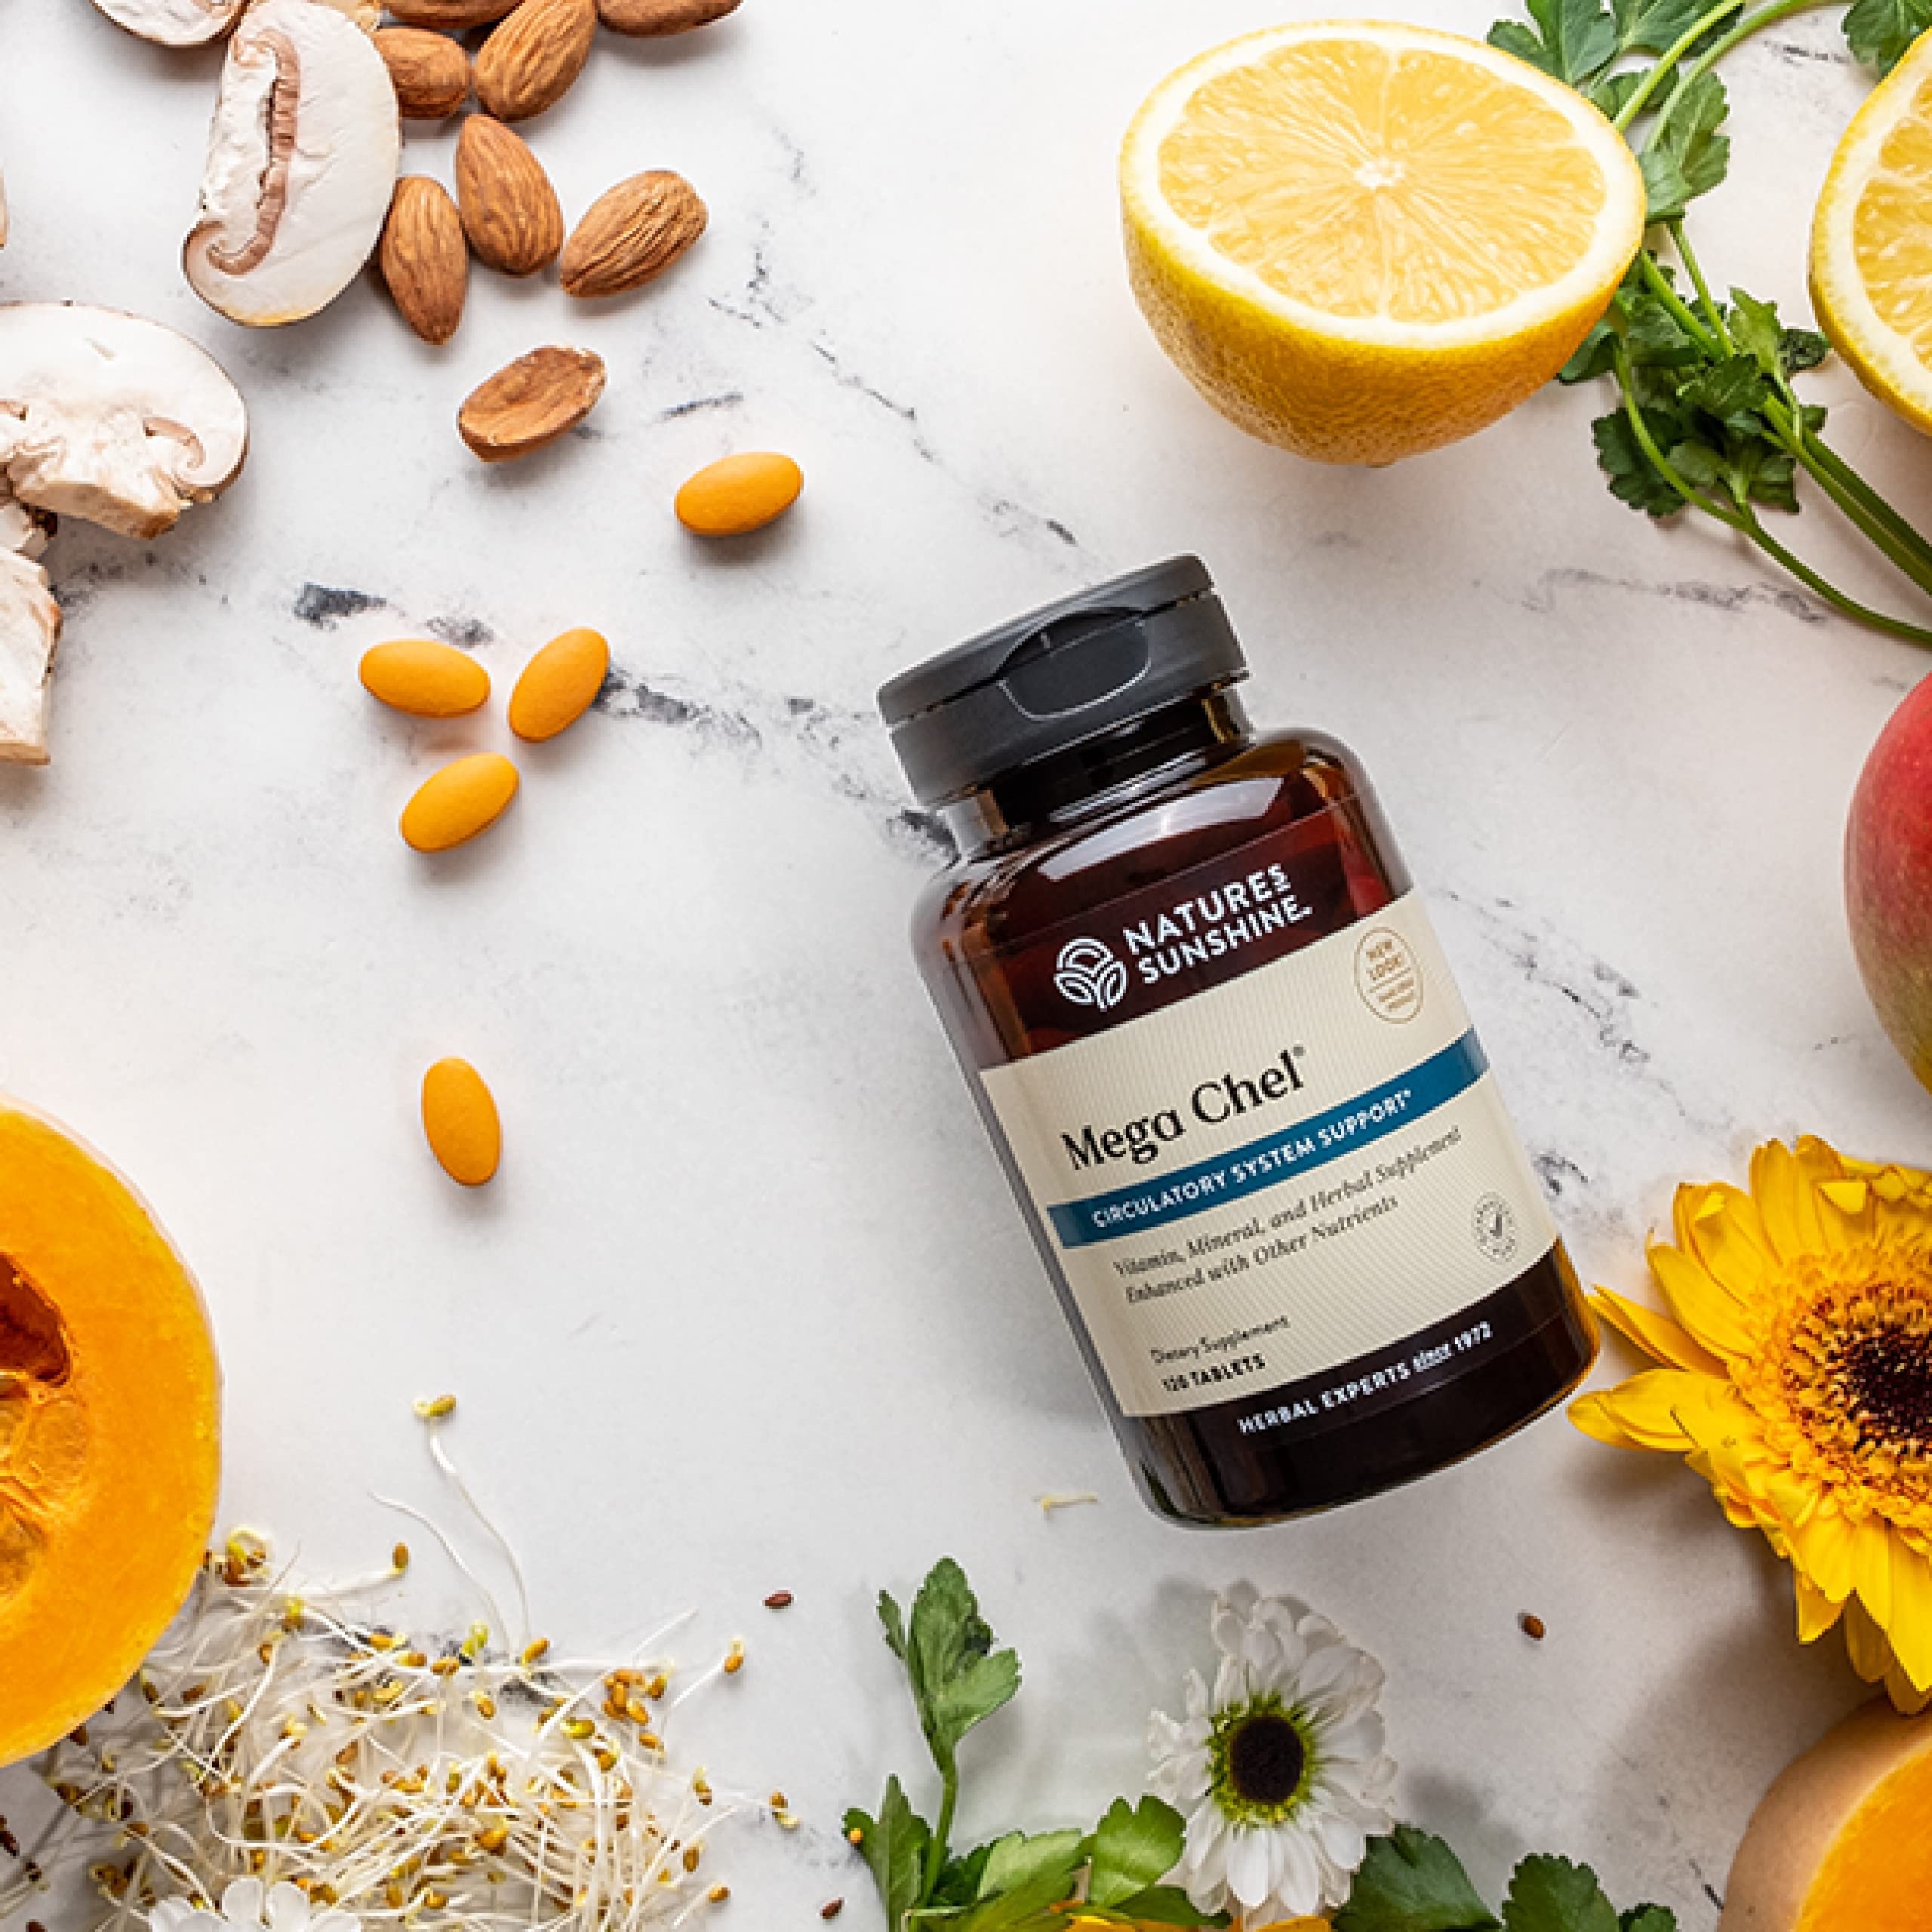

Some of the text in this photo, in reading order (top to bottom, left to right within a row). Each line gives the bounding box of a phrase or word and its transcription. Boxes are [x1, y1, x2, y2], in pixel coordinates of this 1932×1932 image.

[1060, 1109, 1187, 1171] Mega
[1091, 1169, 1226, 1228] CIRCULATORY
[1229, 1134, 1315, 1183] SYSTEM
[1186, 1217, 1266, 1258] Mineral,
[1270, 1198, 1307, 1230] and
[1309, 1169, 1374, 1212] Herbal
[1375, 1125, 1462, 1183] Supplement
[1125, 1194, 1398, 1304] Enhanced with Other Nutrients
[1190, 1352, 1266, 1386] TABLETS
[1199, 1315, 1291, 1353] Supplement
[1237, 1397, 1319, 1435] HERBAL
[1321, 1361, 1411, 1411] EXPERTS
[1454, 1320, 1494, 1353] 1972
